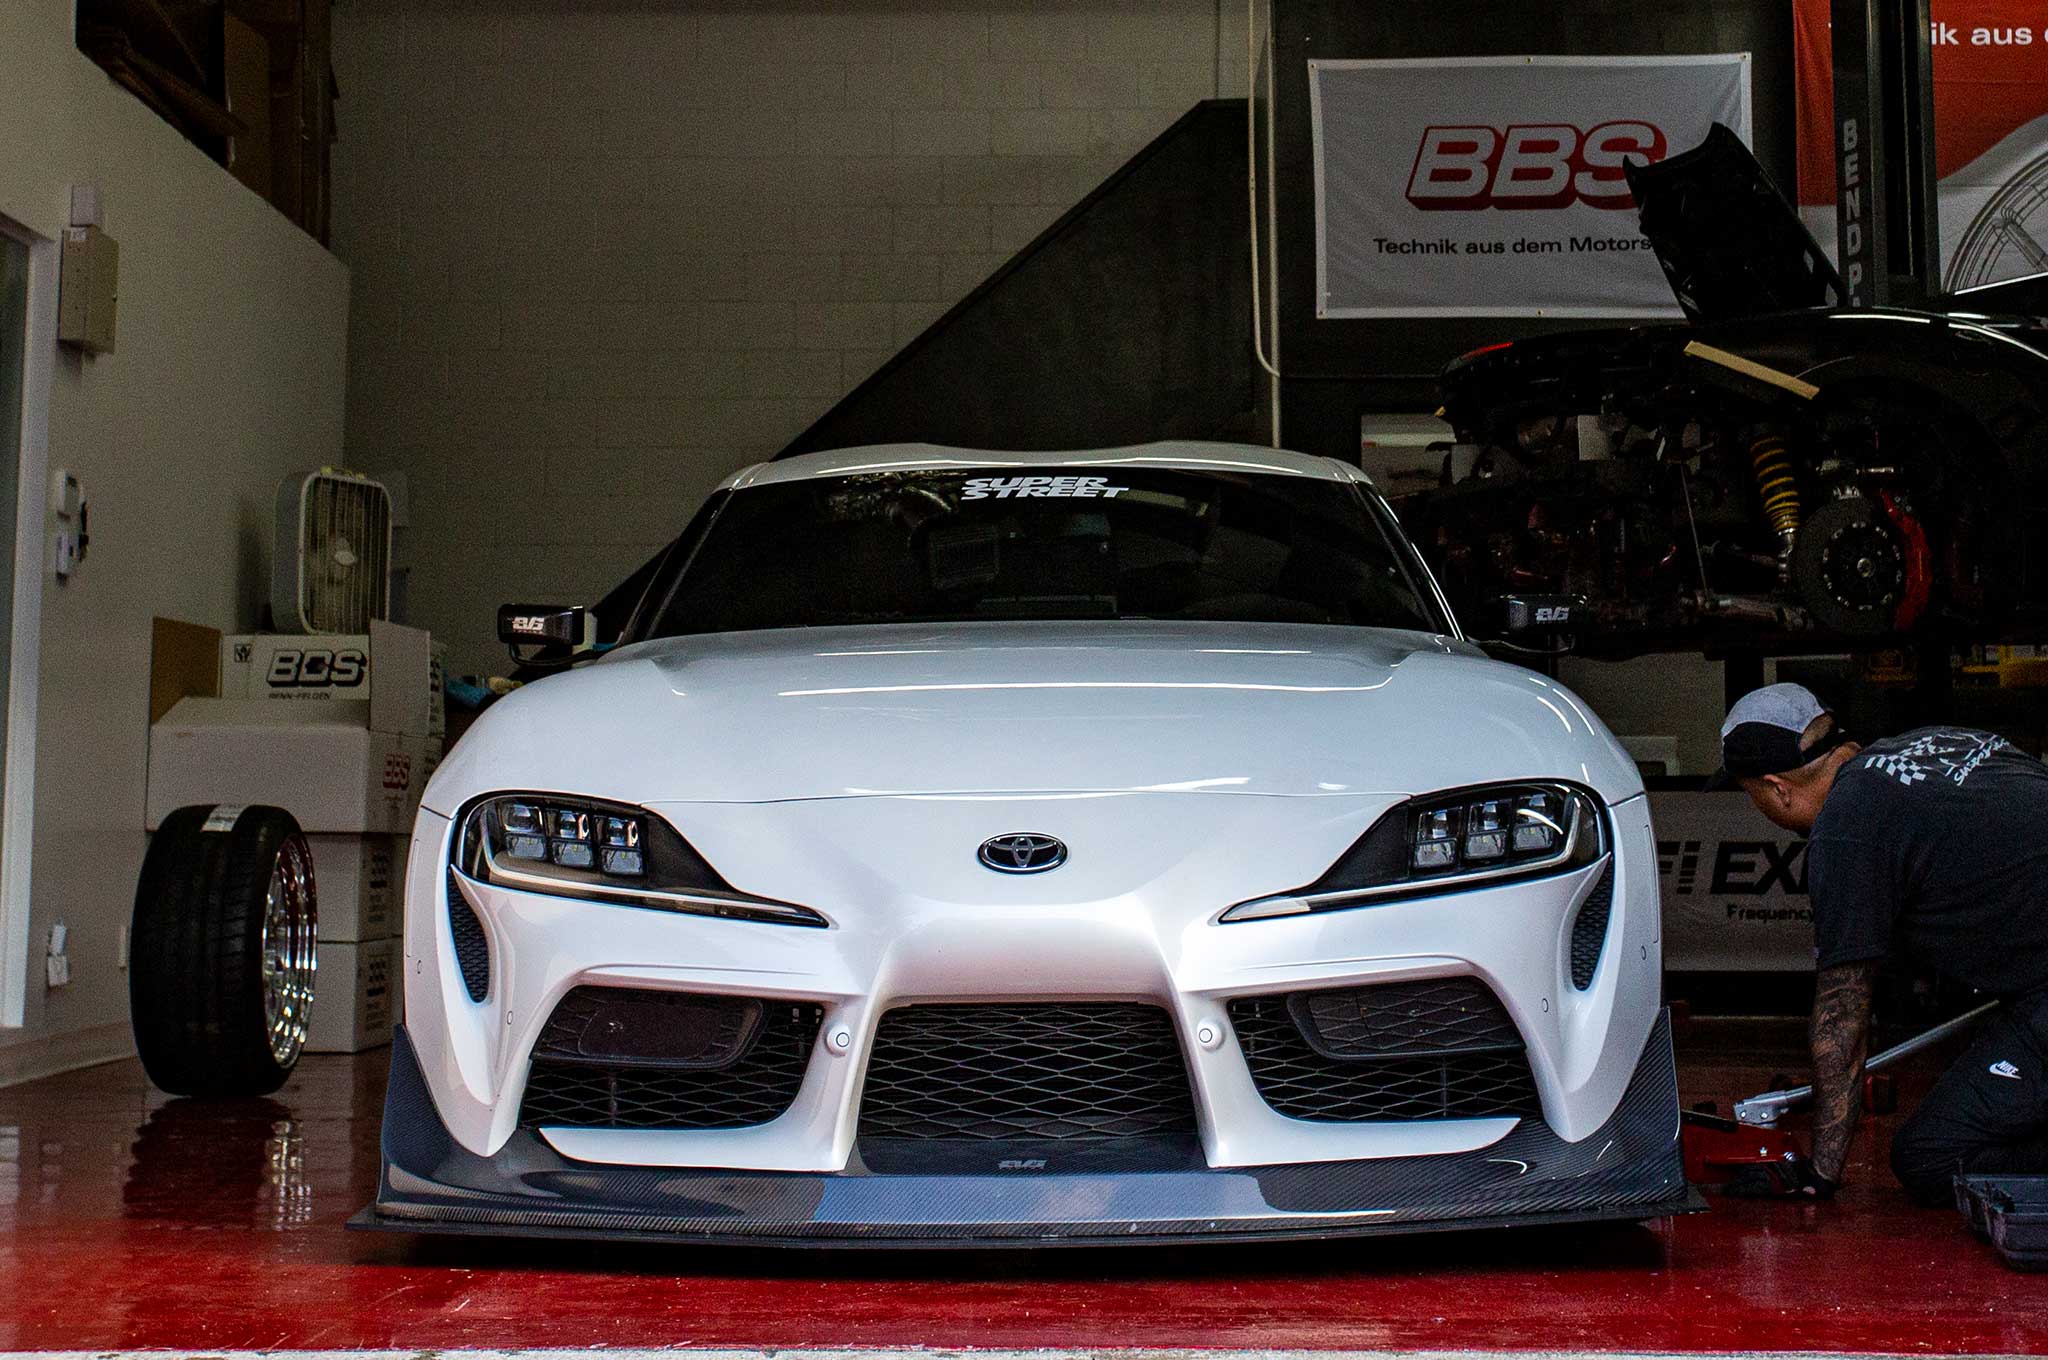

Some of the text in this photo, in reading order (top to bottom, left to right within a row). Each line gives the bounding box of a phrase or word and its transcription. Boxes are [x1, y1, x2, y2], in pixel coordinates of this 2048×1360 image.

[1931, 22, 1960, 45] ik
[1971, 26, 2033, 46] aus
[1405, 120, 1668, 210] BBS
[1373, 236, 1653, 255] Technik aus dem Motors
[961, 476, 1109, 491] SUPER
[961, 486, 1130, 501] STREET
[1710, 841, 1810, 895] EX
[1728, 904, 1815, 923] Frequency
